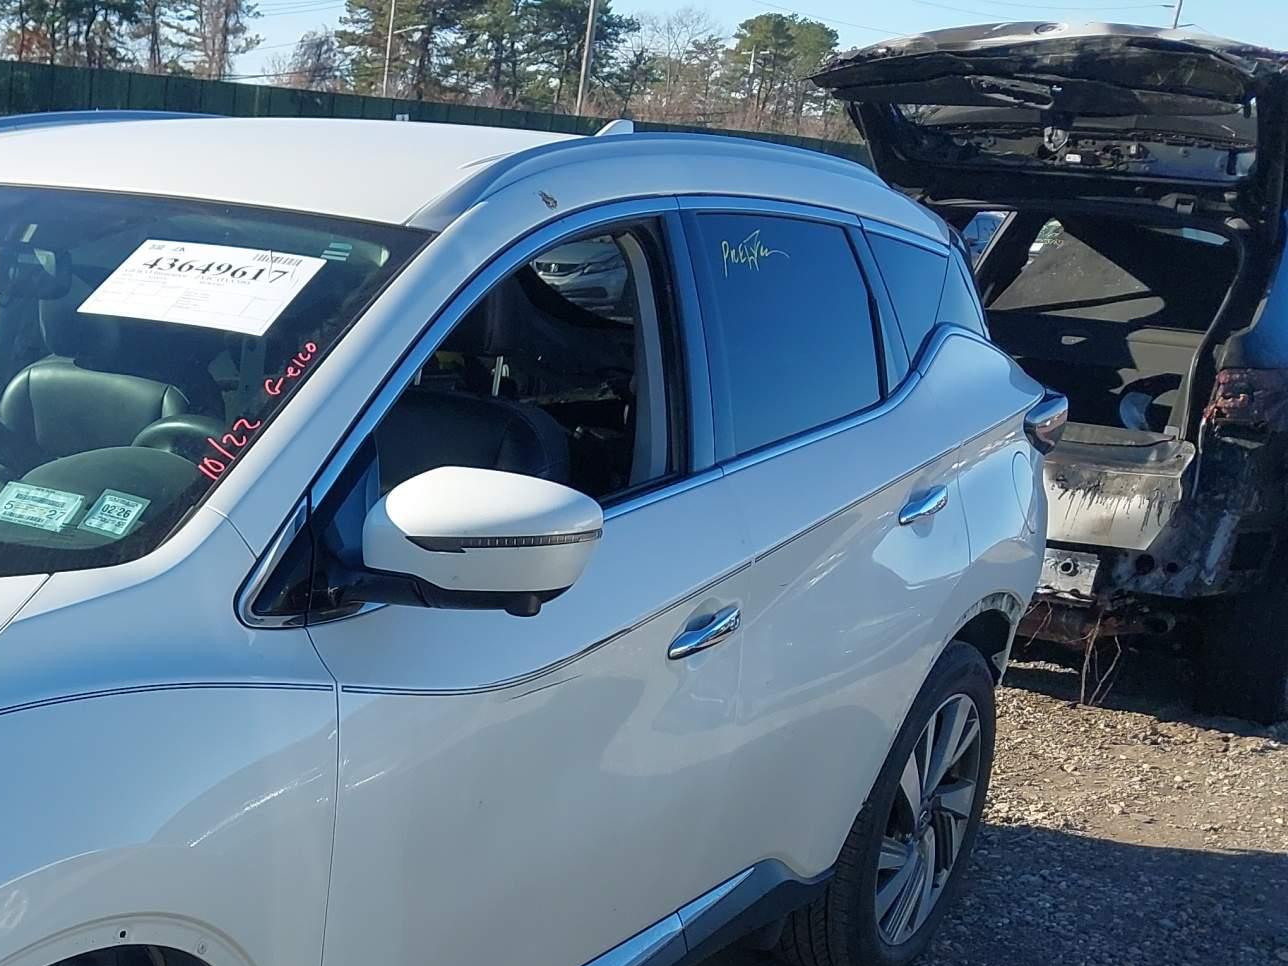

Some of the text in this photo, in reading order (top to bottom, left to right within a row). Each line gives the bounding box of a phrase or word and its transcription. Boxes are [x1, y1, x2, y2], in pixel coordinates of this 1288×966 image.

[142, 256, 289, 284] 43649617
[198, 418, 261, 480] 10/22
[45, 509, 66, 521] 27
